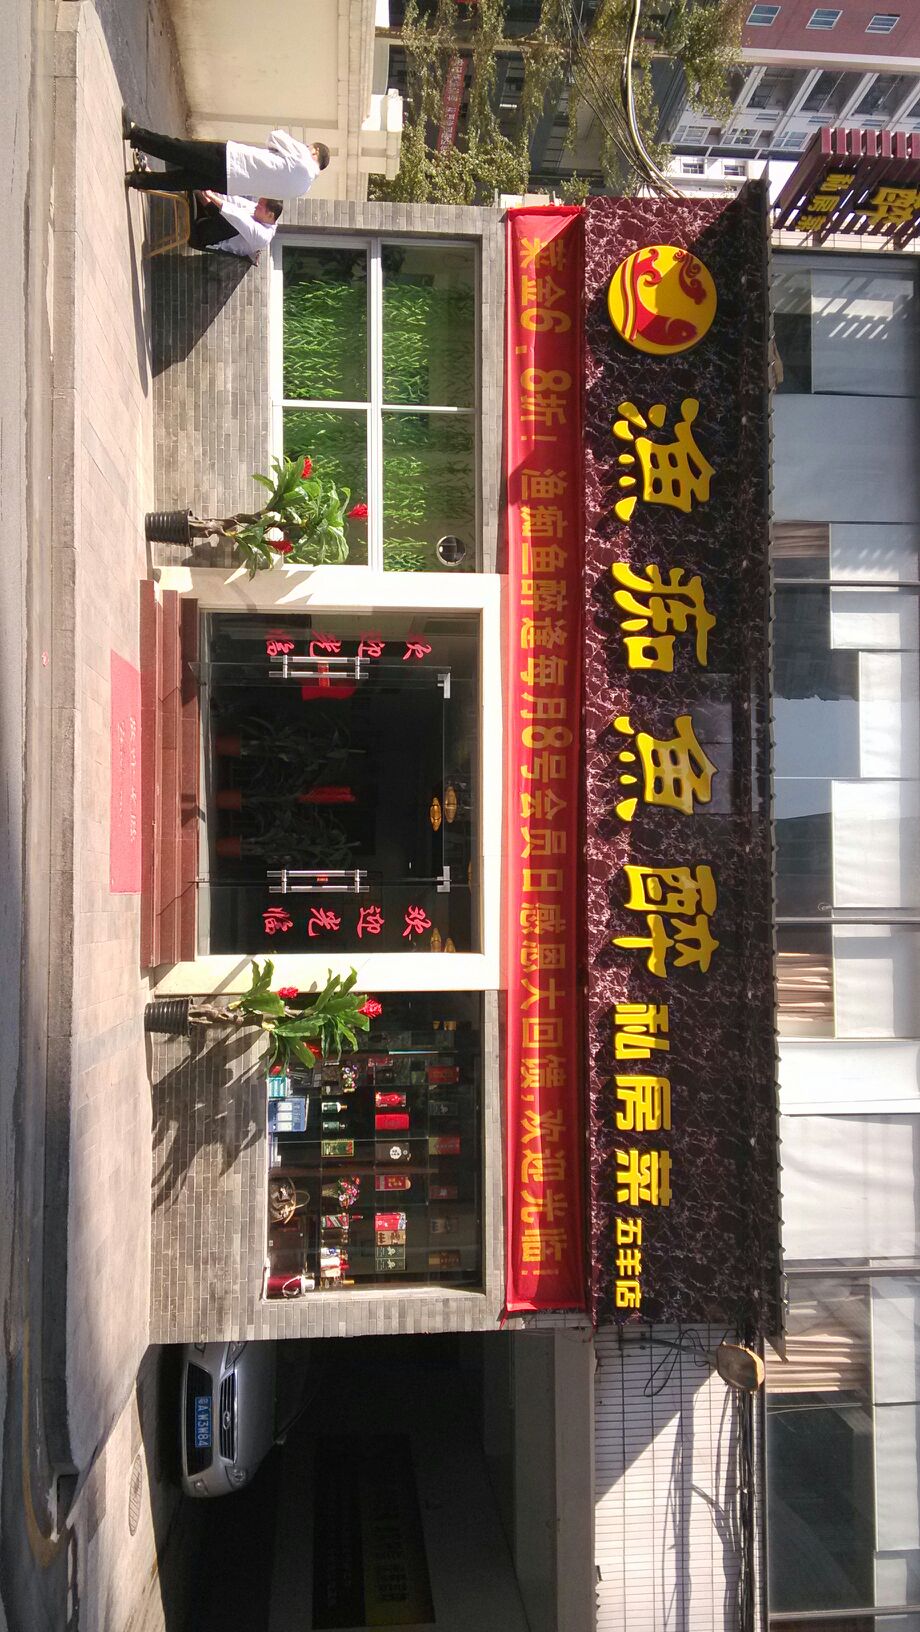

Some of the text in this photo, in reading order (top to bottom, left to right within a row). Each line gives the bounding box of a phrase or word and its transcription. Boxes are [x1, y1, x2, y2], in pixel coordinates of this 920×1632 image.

[796, 173, 855, 231] 私房菜
[611, 398, 718, 1309] 漁痴魚醉 私房菜 五羊店
[263, 905, 432, 938] 欢迎光临
